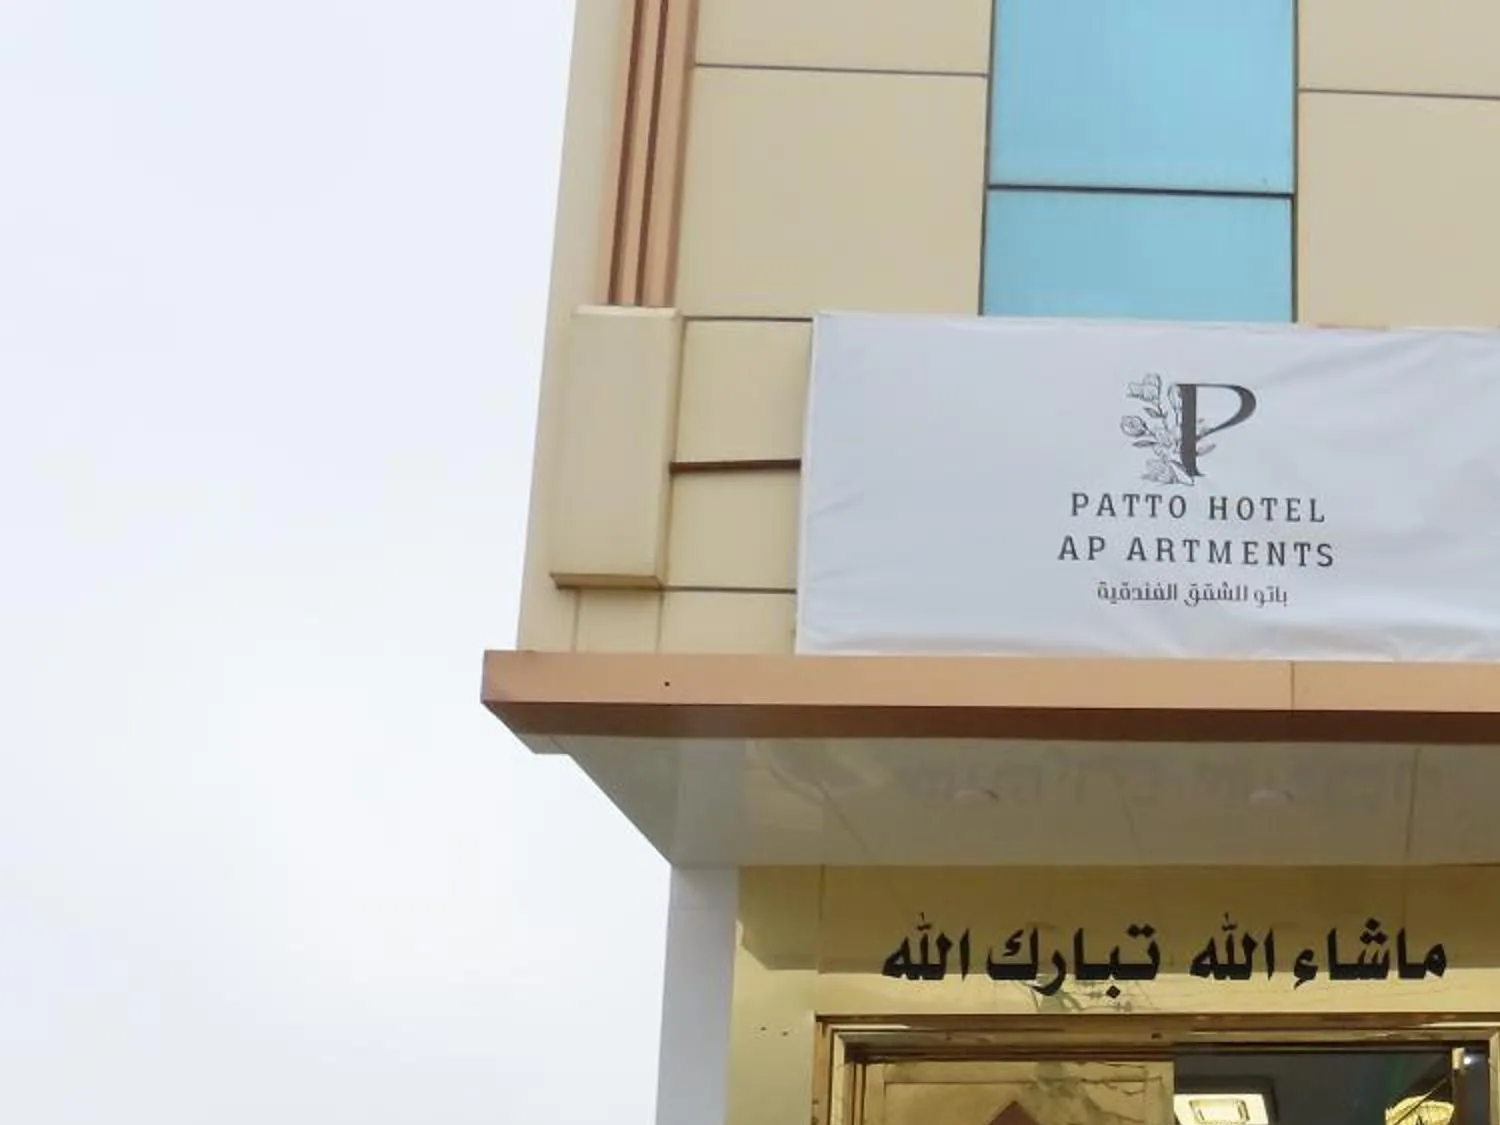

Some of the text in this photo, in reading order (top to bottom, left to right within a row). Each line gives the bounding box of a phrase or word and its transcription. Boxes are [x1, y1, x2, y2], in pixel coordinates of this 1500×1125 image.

[1175, 383, 1256, 477] P
[1070, 492, 1325, 523] PATTO HOTEL
[1097, 582, 1177, 604] الفندقية
[1253, 586, 1288, 608] باتو
[986, 924, 1160, 998] تبارك
